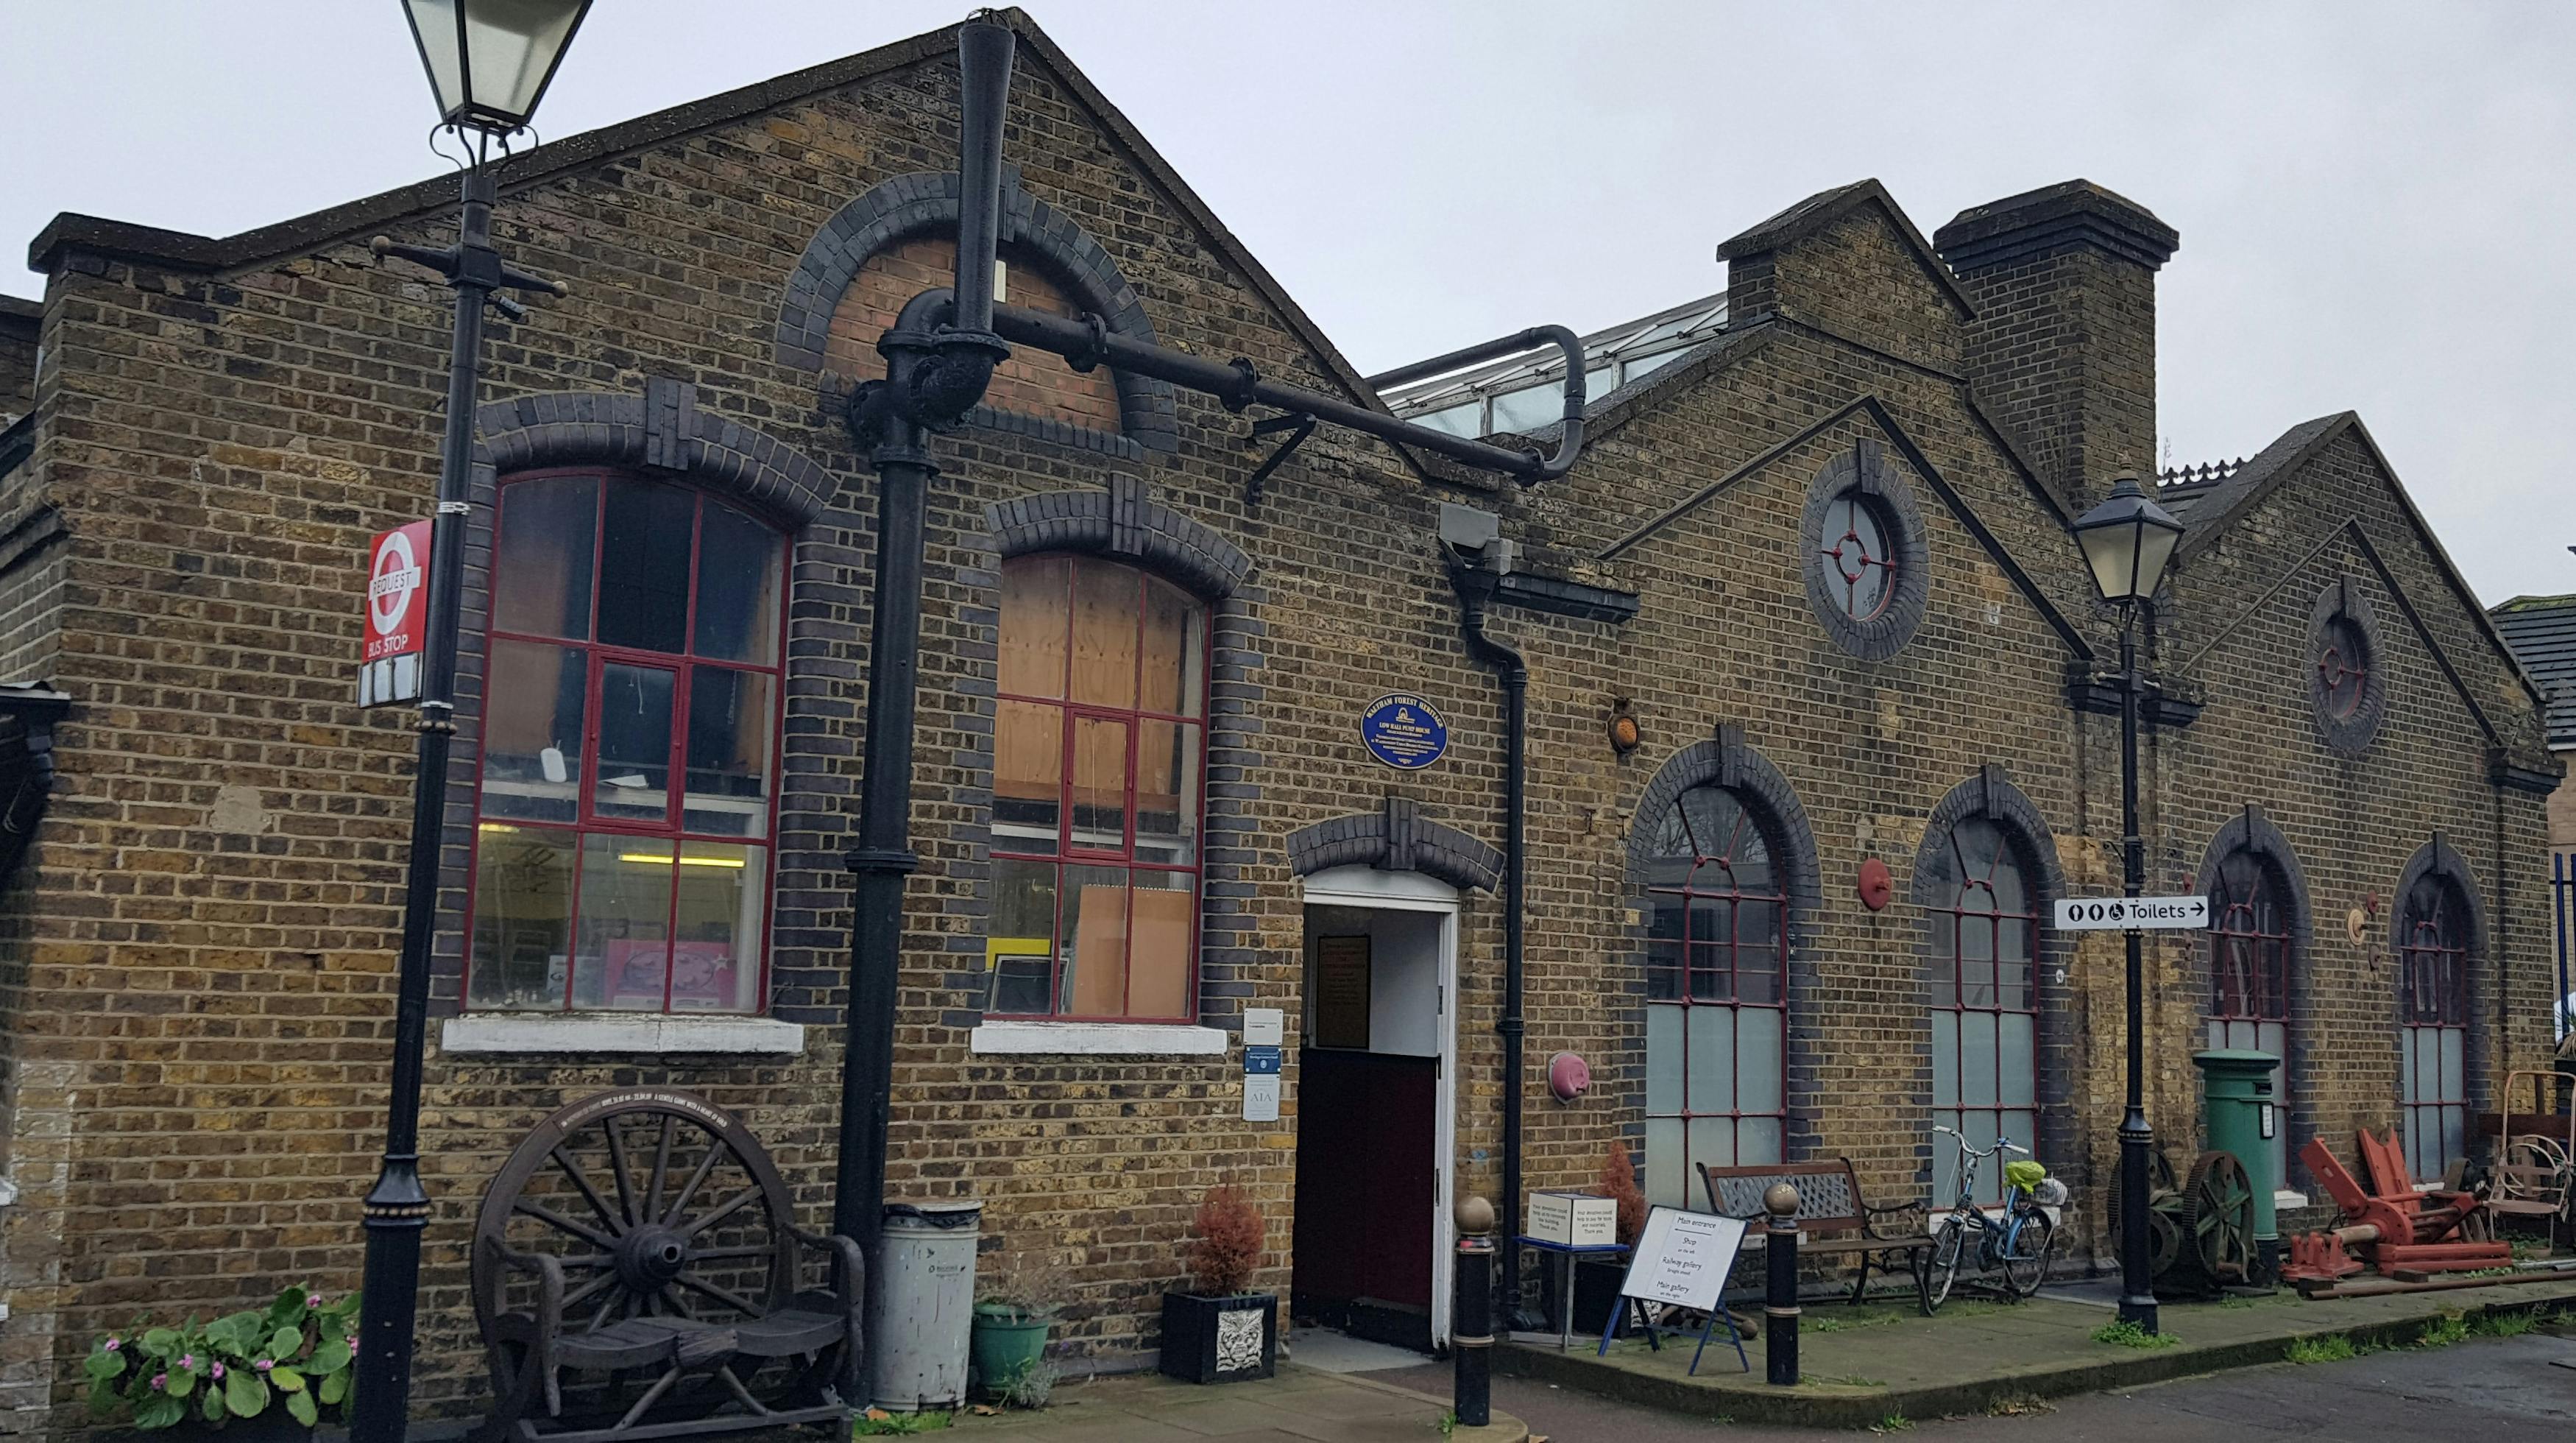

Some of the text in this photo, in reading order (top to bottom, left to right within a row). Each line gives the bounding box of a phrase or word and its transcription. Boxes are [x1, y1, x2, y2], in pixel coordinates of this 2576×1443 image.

[372, 571, 413, 595] REQUEST
[368, 634, 408, 657] BUS STOP
[1366, 696, 1444, 730] WALTHAM FOREST HERITAGE
[2129, 904, 2186, 919] Toilets
[1250, 1093, 1272, 1103] AIA
[1677, 1216, 1717, 1229] Main entrance
[1682, 1236, 1697, 1246] Shop
[1662, 1256, 1702, 1271] Railway gallery
[1656, 1280, 1690, 1294] Main gallery
